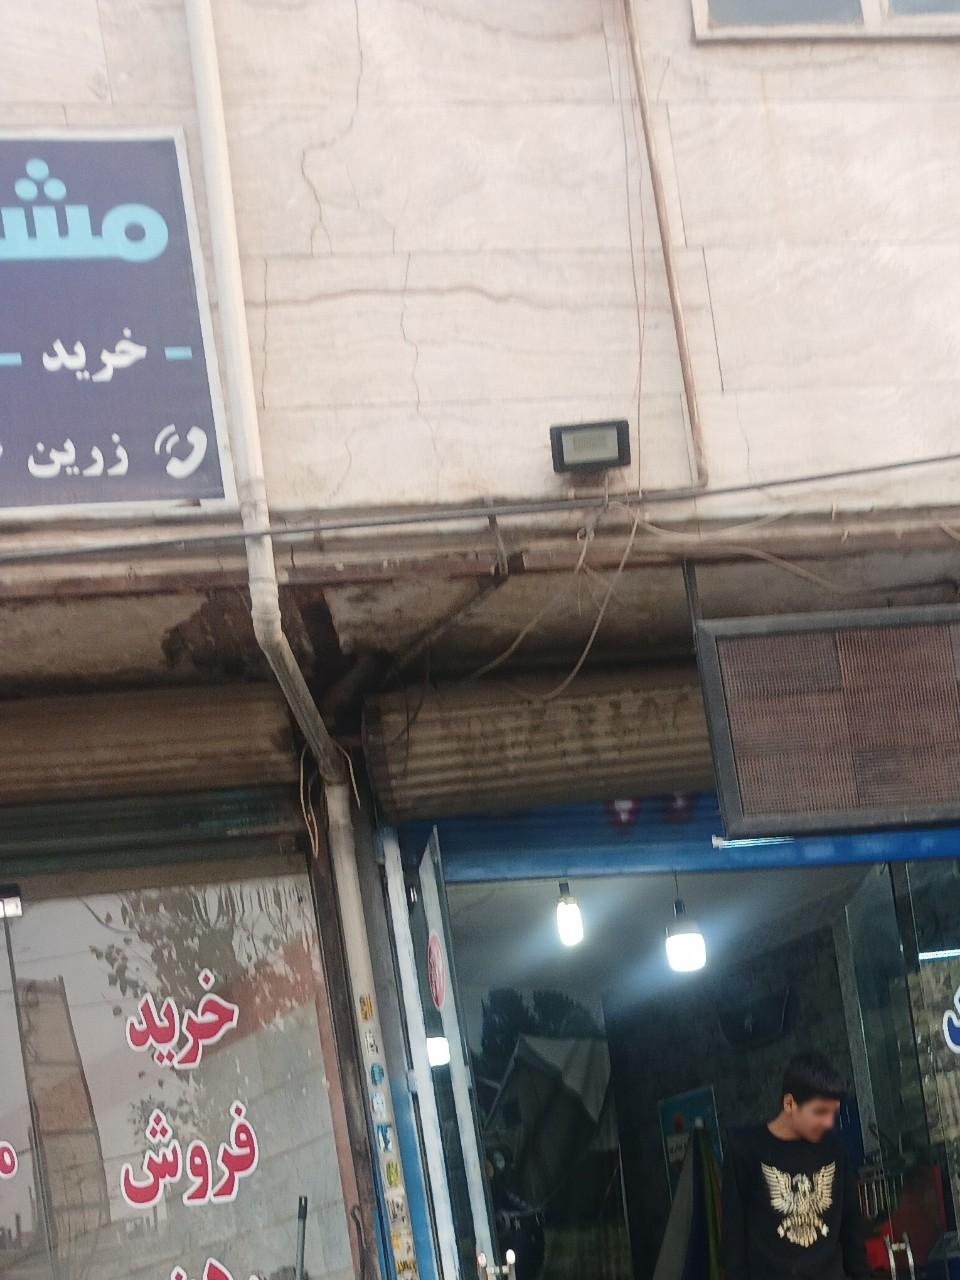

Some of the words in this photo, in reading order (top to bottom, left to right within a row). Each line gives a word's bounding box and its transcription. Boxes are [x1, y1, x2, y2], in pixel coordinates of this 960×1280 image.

[0, 158, 169, 262] مش
[42, 327, 147, 382] خرید
[27, 433, 129, 478] زرین
[126, 968, 240, 1071] خرید
[120, 1100, 258, 1207] فروش
